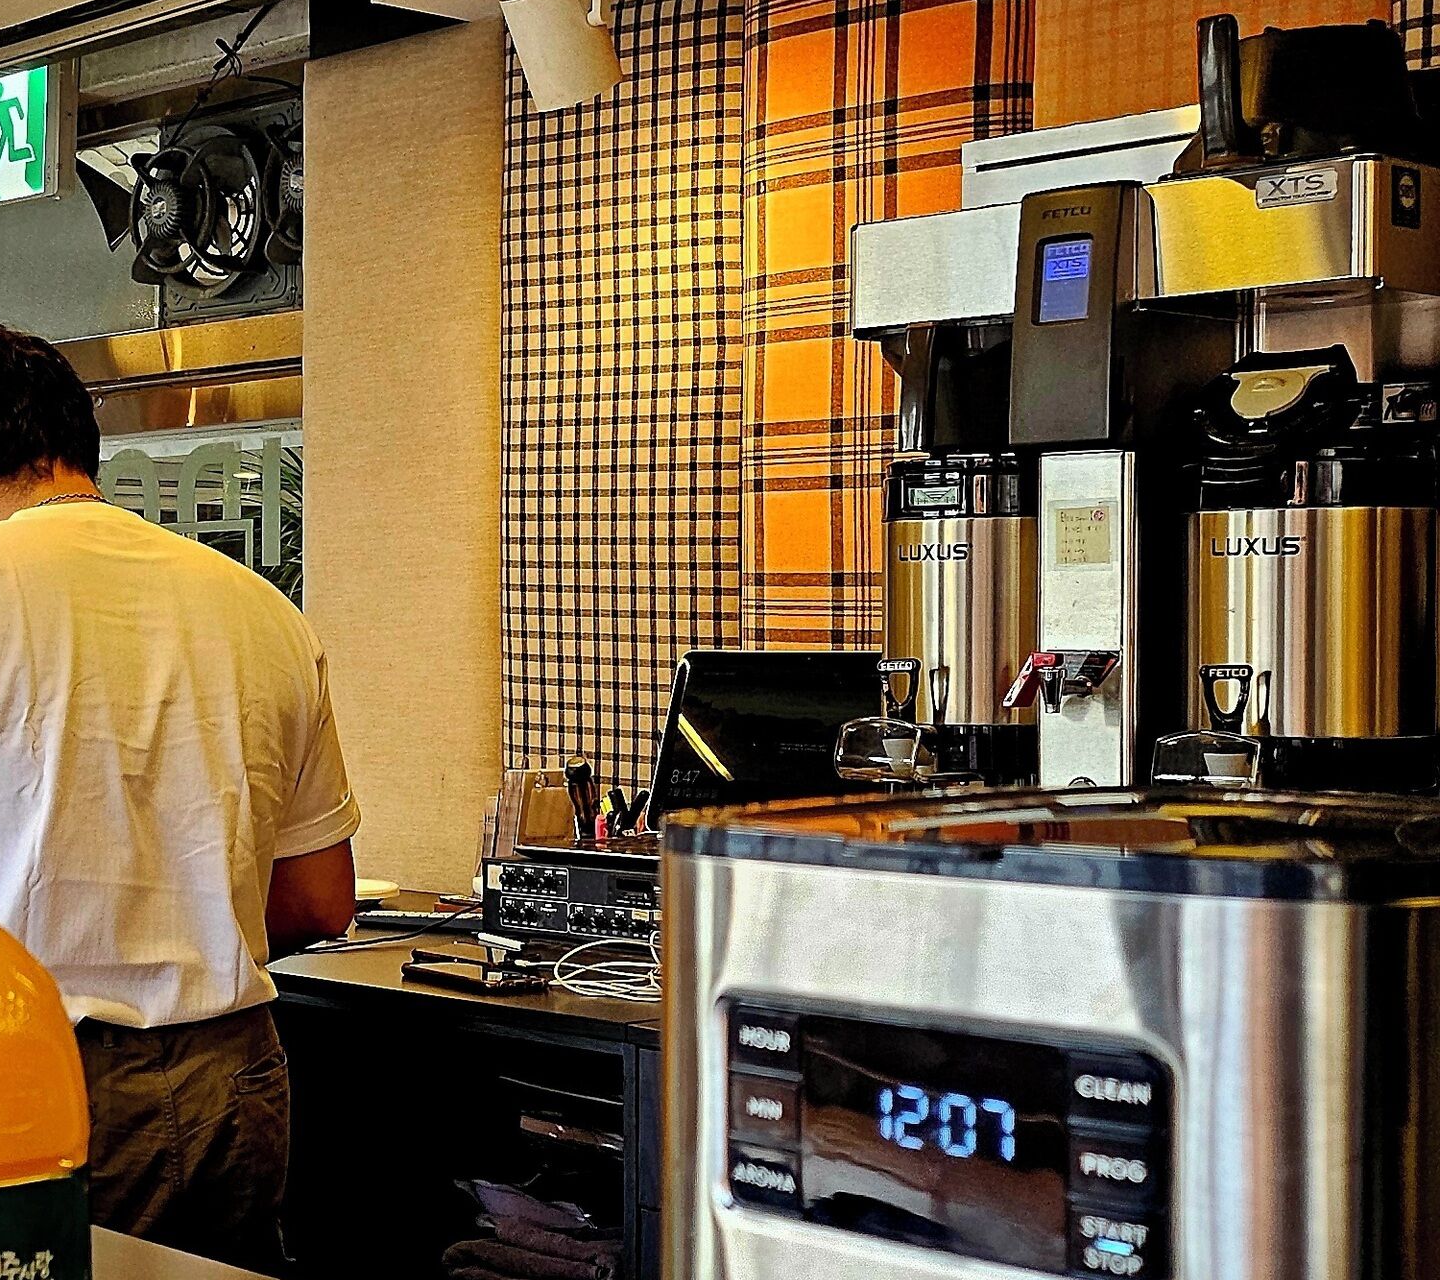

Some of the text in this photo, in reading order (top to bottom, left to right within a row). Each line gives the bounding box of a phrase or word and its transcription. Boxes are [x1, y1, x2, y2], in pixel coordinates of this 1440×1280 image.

[1268, 174, 1324, 196] XTS
[1052, 259, 1082, 270] XTS
[898, 544, 969, 562] LUXUS
[1210, 535, 1303, 557] LUXUS
[880, 661, 913, 670] FETCO
[1208, 668, 1248, 678] FETCO
[670, 769, 700, 784] 8:47
[739, 1025, 791, 1053] HOUR
[1074, 1074, 1152, 1106] CLEAN
[746, 1096, 783, 1121] MIN
[733, 1161, 797, 1194] AROMA
[1079, 1152, 1148, 1183] PROG
[1079, 1215, 1150, 1248] START
[1083, 1244, 1144, 1276] STOP
